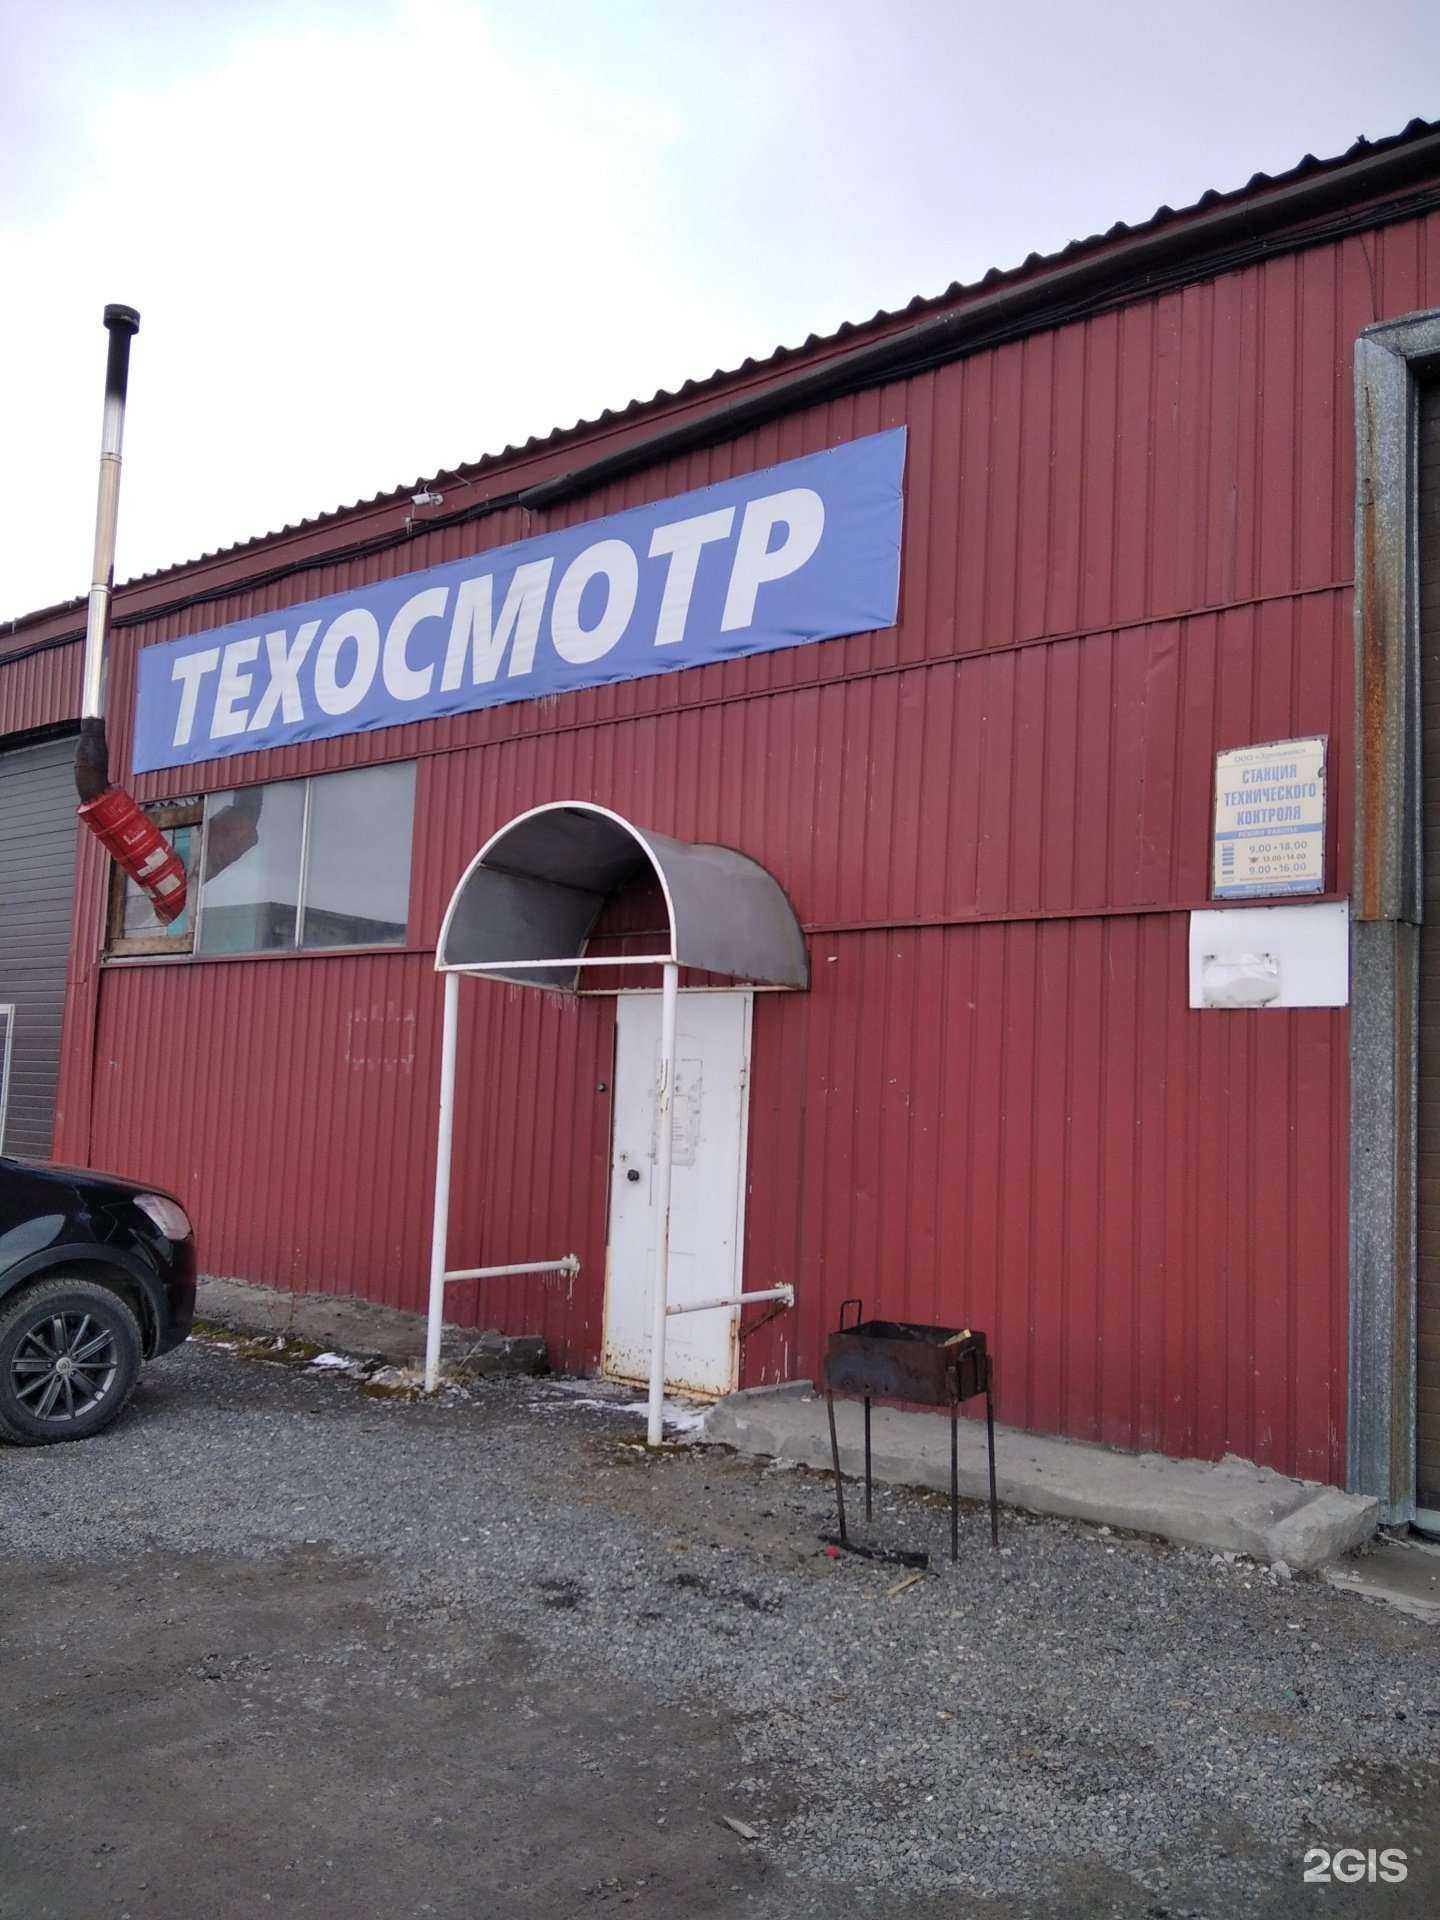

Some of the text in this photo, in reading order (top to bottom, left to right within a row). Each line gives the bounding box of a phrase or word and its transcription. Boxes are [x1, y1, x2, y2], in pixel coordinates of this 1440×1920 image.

[172, 487, 825, 746] ТЕХОСМОТР
[1242, 764, 1297, 784] СТАНЦИЯ
[1224, 783, 1317, 807] ТЕХНИЧЕСКОГО
[1237, 806, 1301, 825] КОНТРОЛЯ
